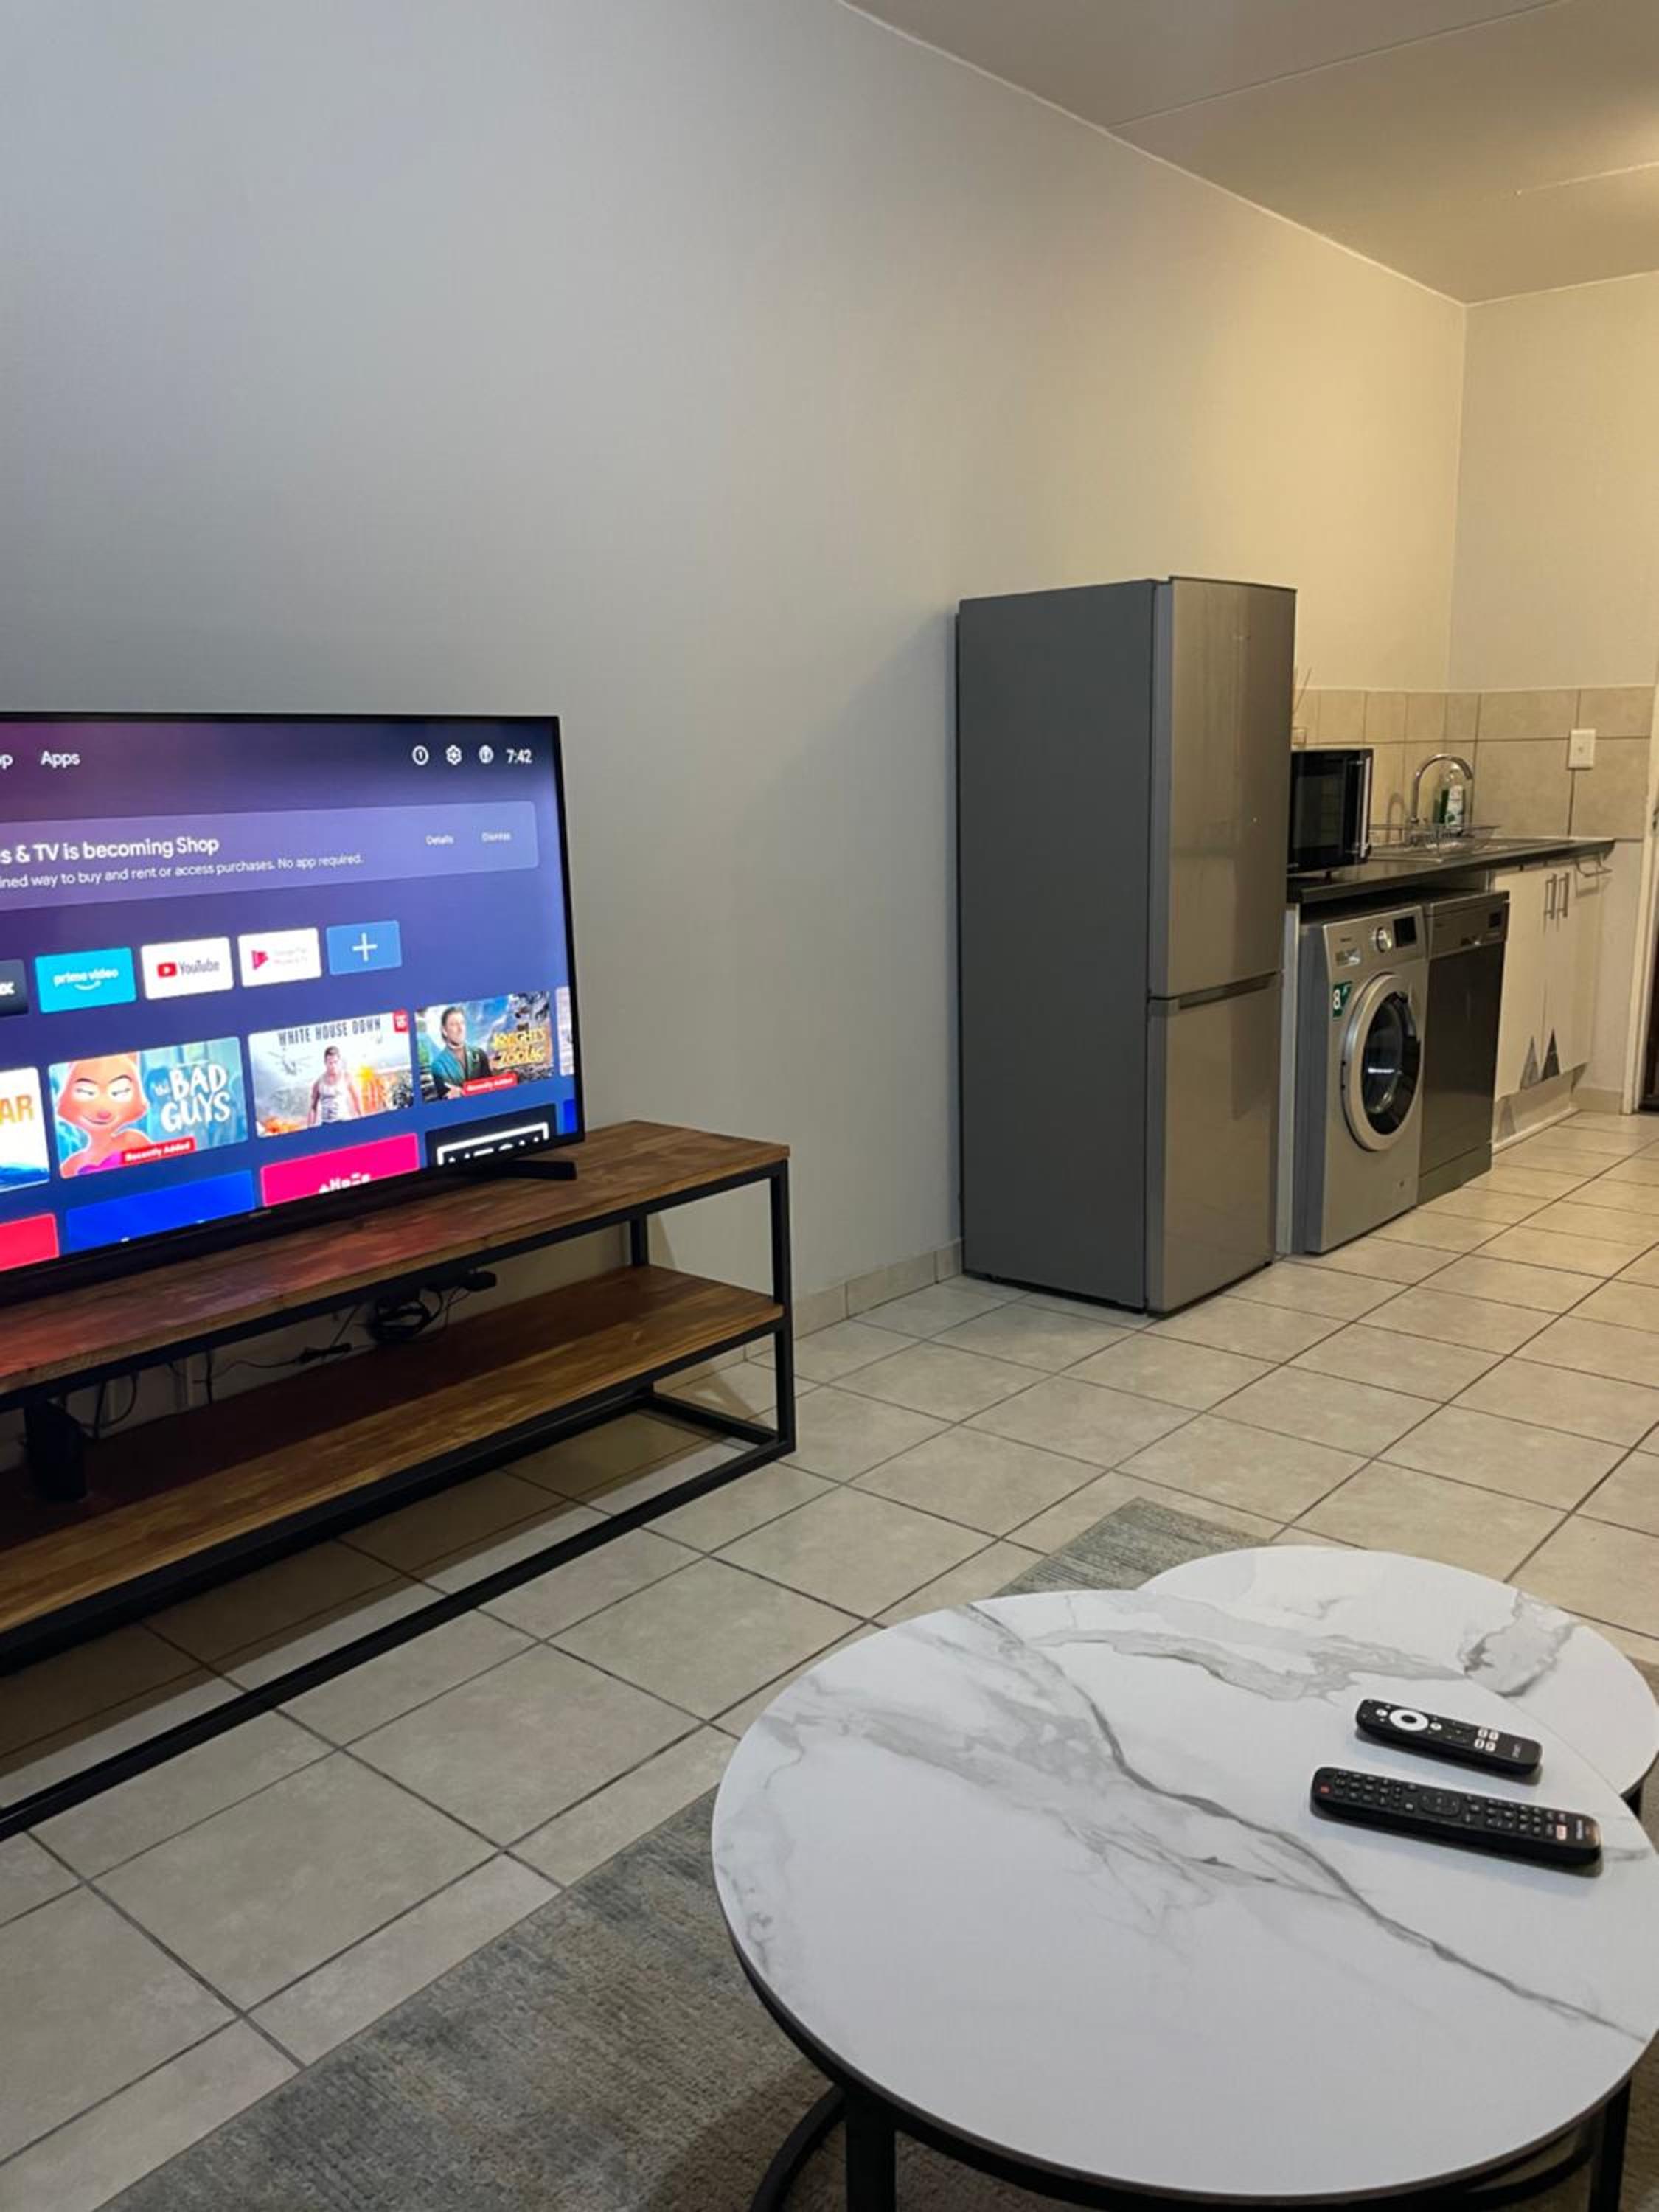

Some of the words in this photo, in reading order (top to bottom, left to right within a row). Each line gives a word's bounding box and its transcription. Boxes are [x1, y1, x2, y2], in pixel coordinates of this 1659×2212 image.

[41, 751, 80, 768] Apps
[507, 748, 532, 764] 7:42
[15, 845, 30, 863] &
[33, 844, 59, 861] TV
[63, 843, 79, 860] is
[83, 838, 173, 858] becoming
[176, 836, 220, 855] Shop
[30, 874, 57, 889] way
[61, 872, 75, 884] to
[78, 869, 102, 884] buy
[105, 868, 129, 881] and
[131, 866, 156, 879] rent
[159, 866, 171, 877] or
[175, 863, 215, 877] access
[216, 859, 275, 875] purchases.
[278, 858, 293, 869] No
[296, 856, 316, 869] app
[318, 852, 364, 867] required.
[53, 972, 87, 987] prime
[88, 967, 119, 981] video
[178, 958, 220, 975] YouTube
[278, 1027, 311, 1046] WHITE
[316, 1022, 348, 1040] HOUSE
[352, 1018, 381, 1034] DOWN
[170, 1063, 228, 1100] BAD
[161, 1091, 230, 1133] GUYS
[125, 1146, 162, 1162] Recently
[163, 1141, 191, 1155] Added
